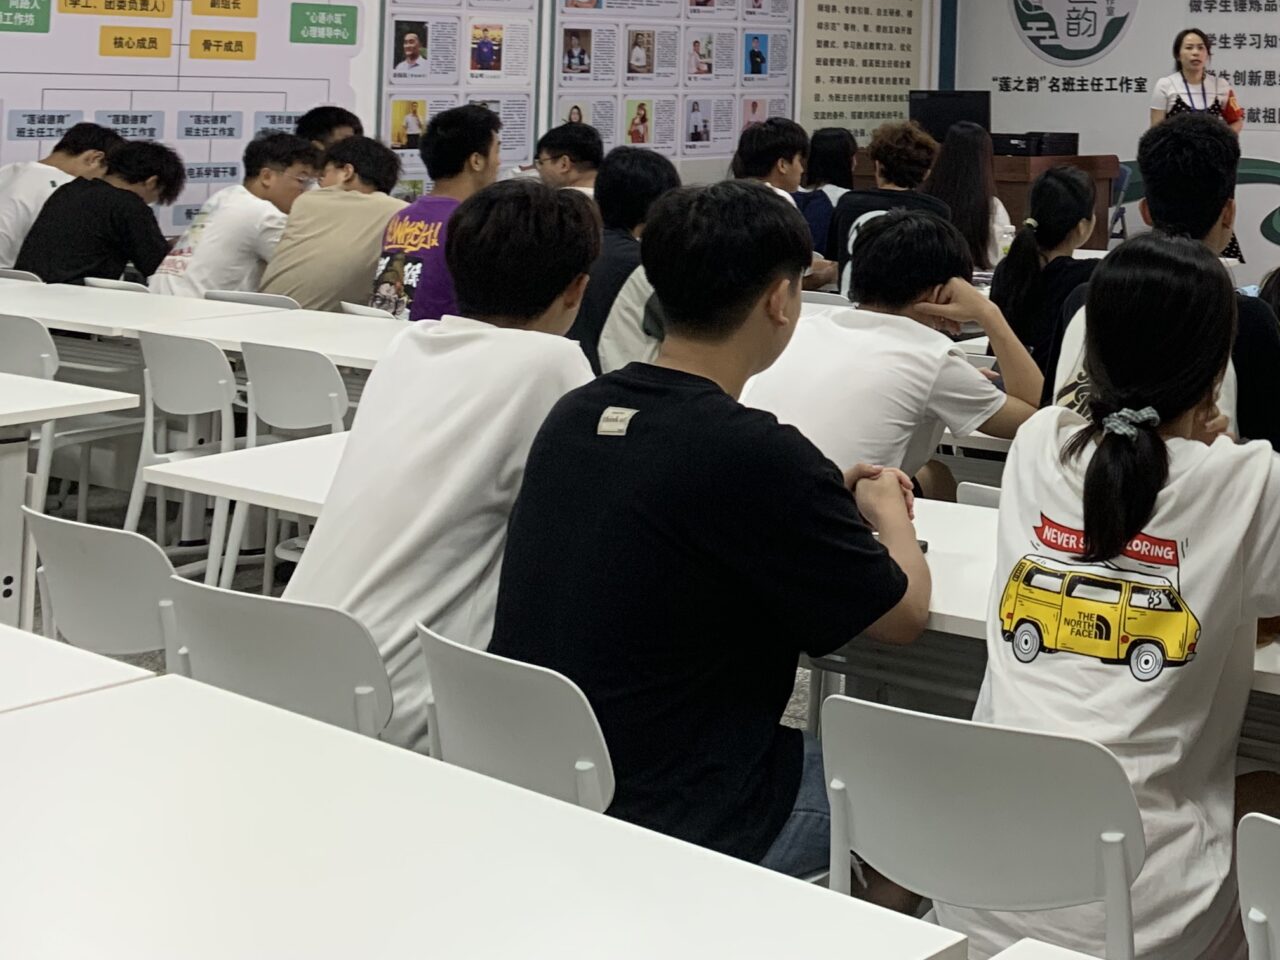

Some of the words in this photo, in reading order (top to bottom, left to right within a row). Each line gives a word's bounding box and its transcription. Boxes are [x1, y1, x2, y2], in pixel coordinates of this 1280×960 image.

[114, 36, 159, 50] 核心成员
[202, 39, 244, 53] 骨干成员
[16, 127, 69, 138] 班主任工作
[1042, 525, 1077, 549] NEVER
[1077, 611, 1096, 622] THE
[1063, 617, 1095, 629] NORTH
[1070, 628, 1095, 639] FACE
